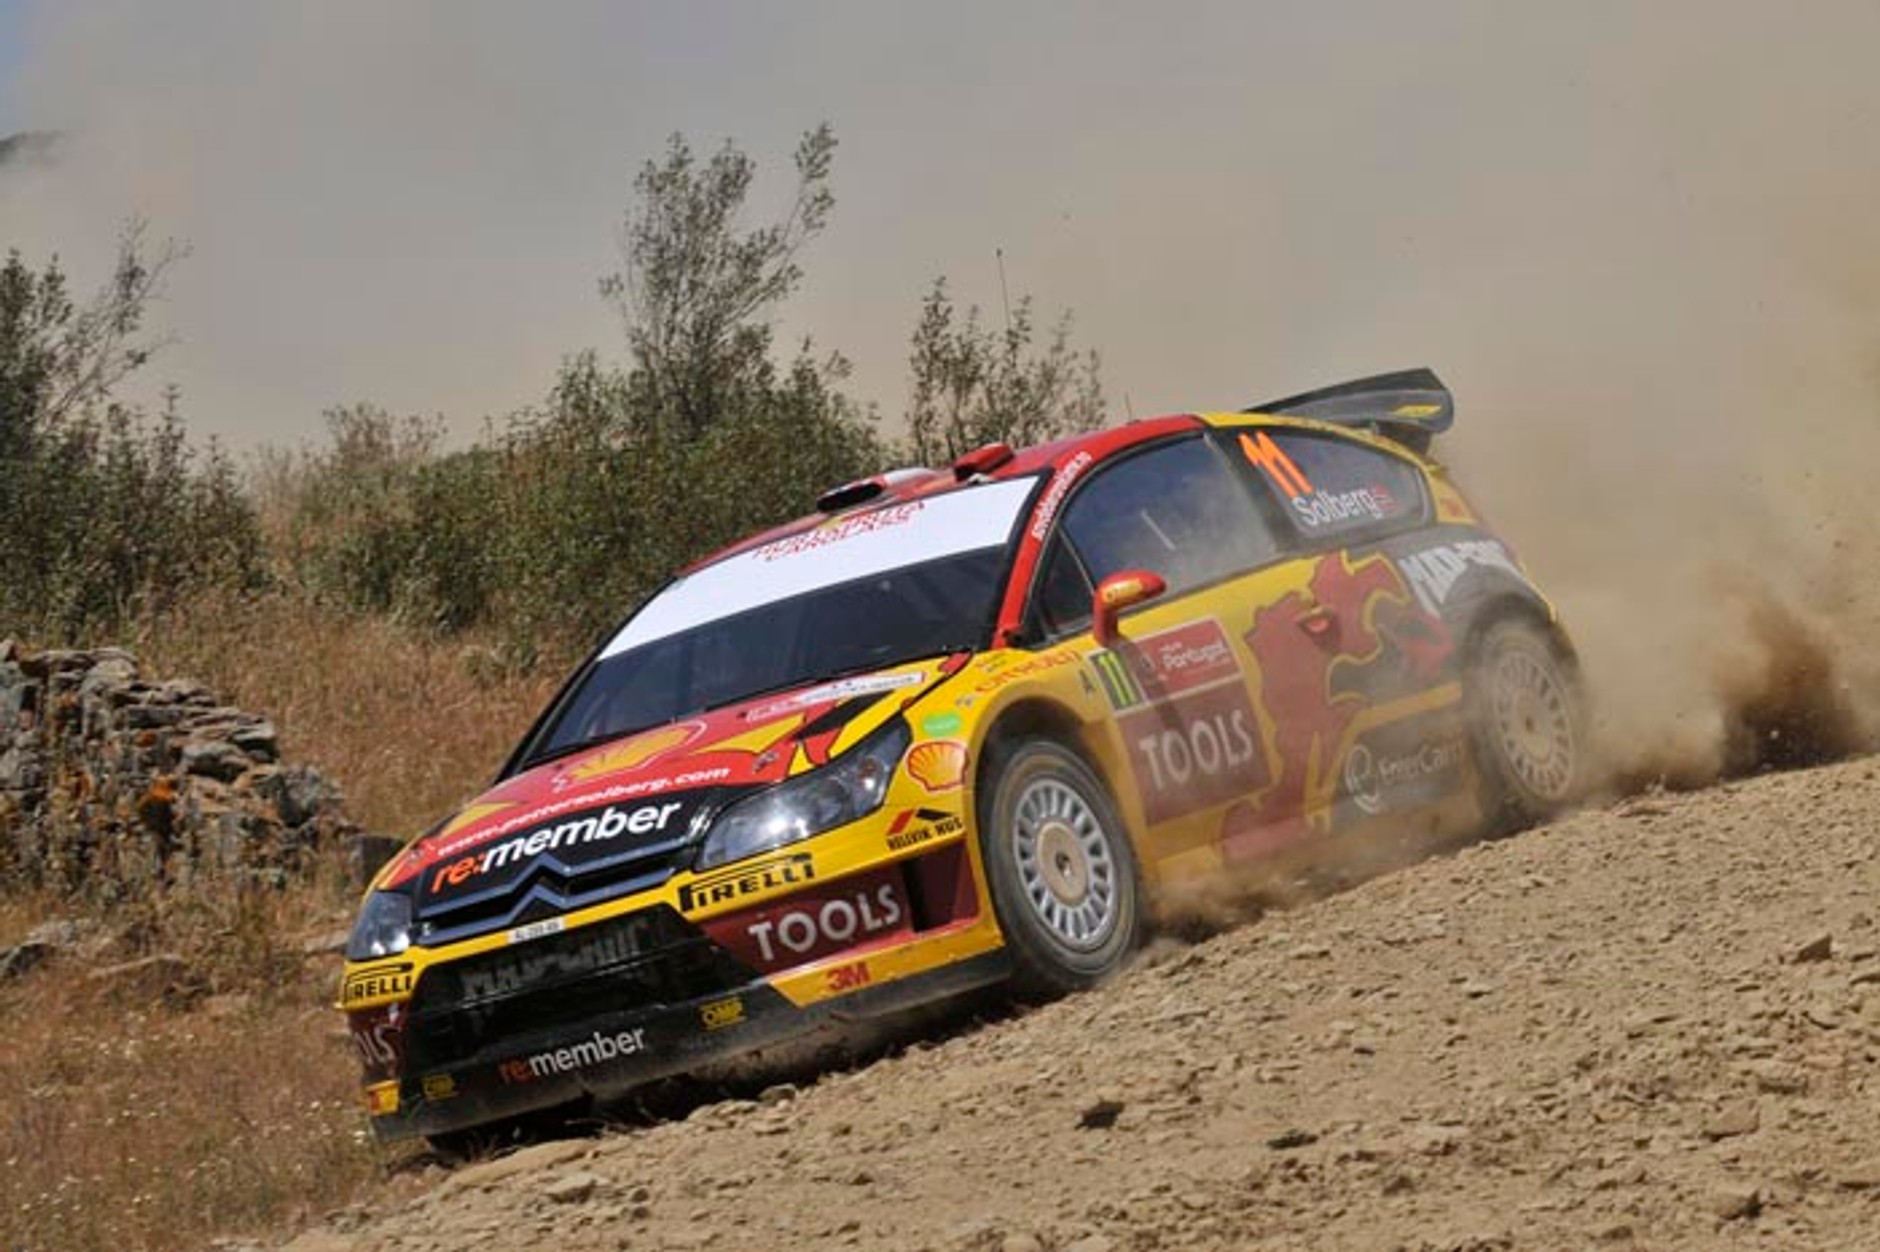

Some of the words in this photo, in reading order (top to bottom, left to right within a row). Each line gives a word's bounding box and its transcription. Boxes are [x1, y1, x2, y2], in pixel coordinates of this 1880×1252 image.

[1240, 431, 1313, 498] 11
[1292, 487, 1382, 527] Solberg
[1099, 650, 1138, 707] 11
[1140, 708, 1254, 790] TOOLS
[431, 802, 682, 893] re:member
[678, 853, 816, 912] PIRELLI
[748, 885, 902, 962] TOOLS
[826, 962, 871, 990] 3M
